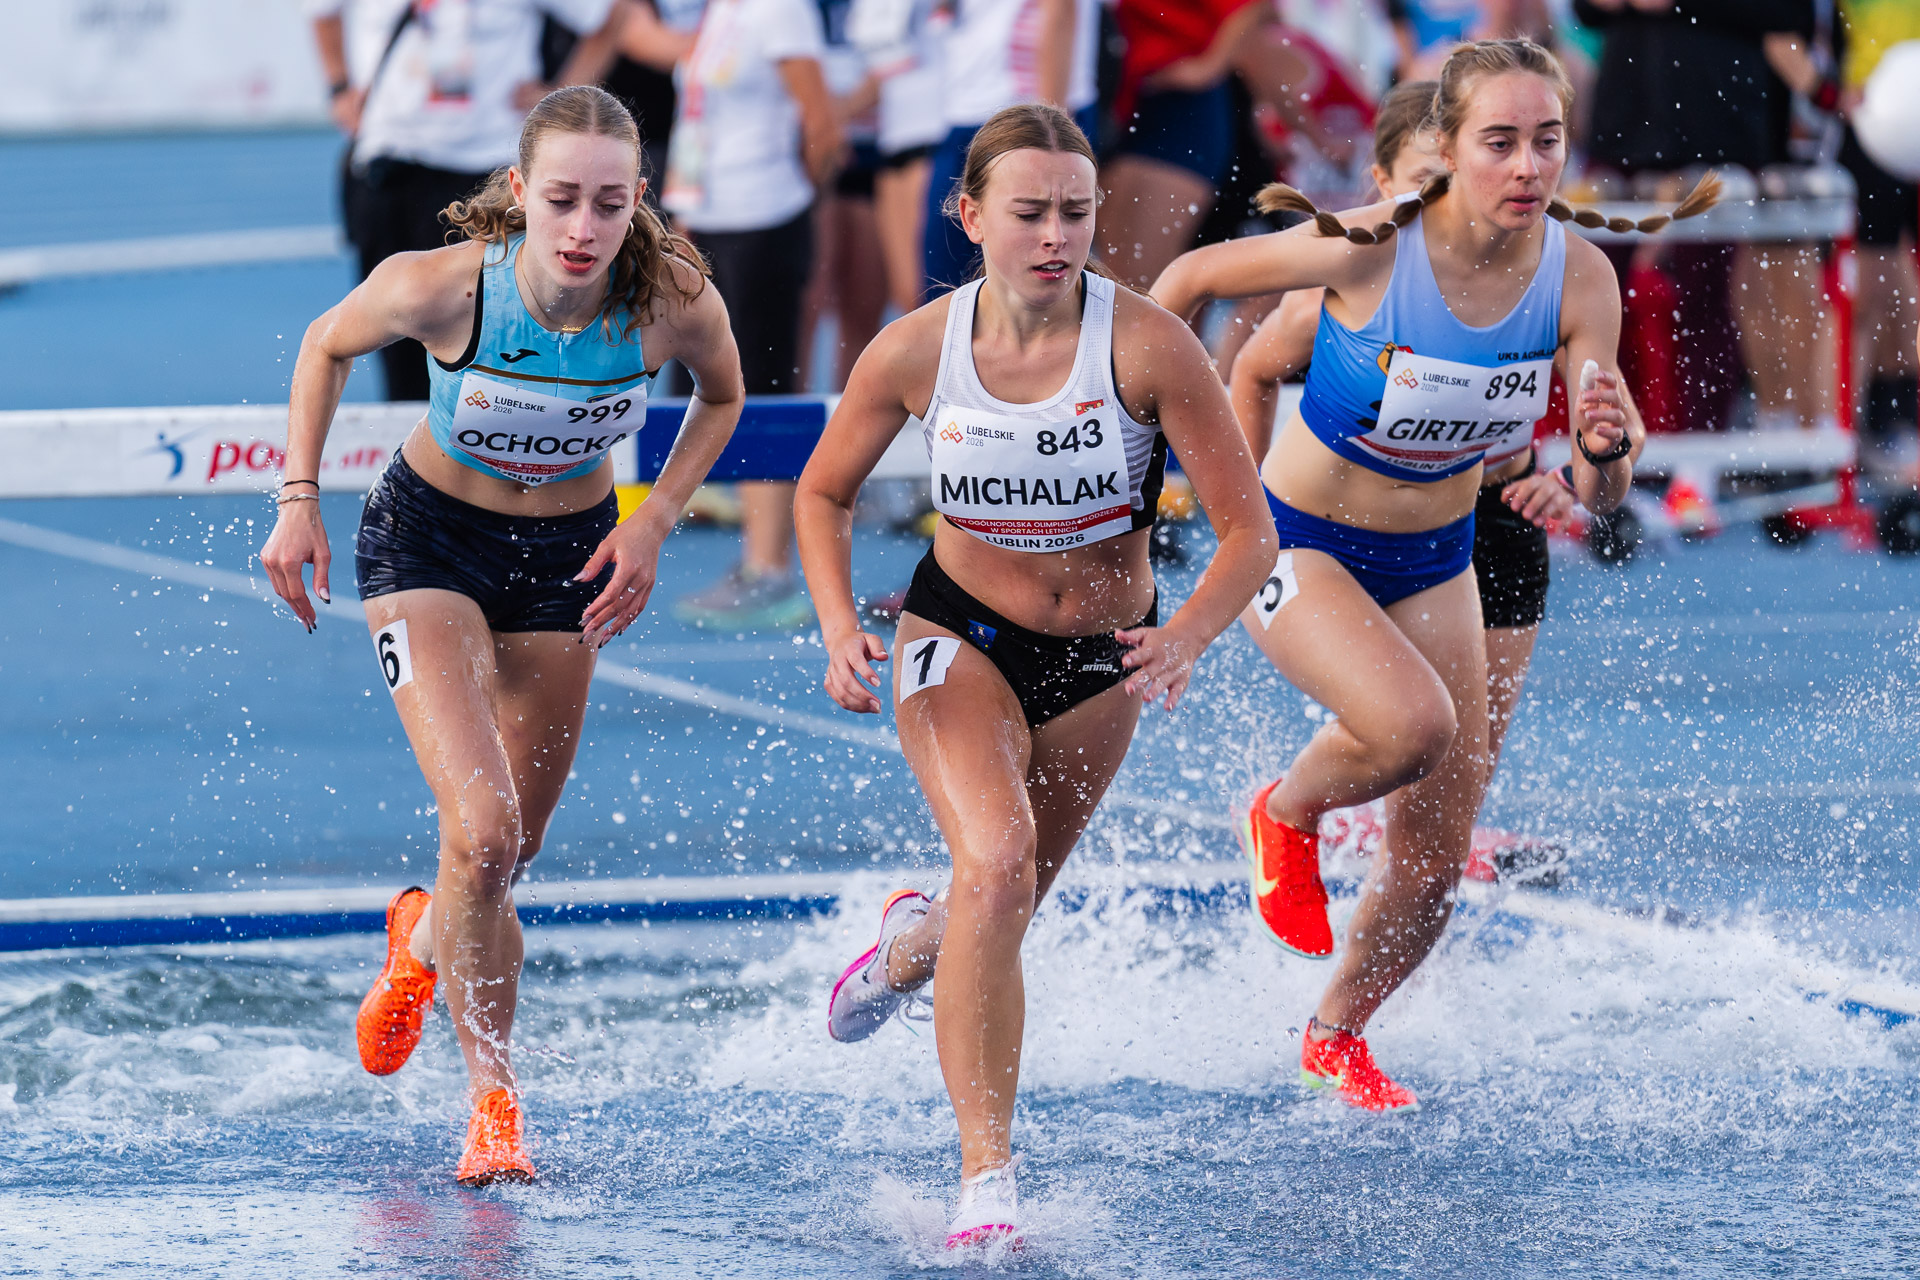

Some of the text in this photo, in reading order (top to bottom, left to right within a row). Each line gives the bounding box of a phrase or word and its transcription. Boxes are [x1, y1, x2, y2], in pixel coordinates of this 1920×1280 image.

[1497, 351, 1519, 361] UKS
[1420, 382, 1439, 393] 2026
[1422, 371, 1471, 388] LUBELSKIE
[1484, 369, 1537, 401] 894
[492, 404, 513, 415] 2026
[494, 395, 547, 413] LUBELSKIE
[567, 398, 632, 424] 999
[966, 424, 1015, 441] LUBELSKIE
[1036, 418, 1104, 456] 843
[965, 436, 985, 448] 2026
[1386, 457, 1435, 470] LUBLIN
[940, 470, 1120, 506] MICHALAK
[967, 520, 1032, 528] OGÓLNOPOLSKA
[1033, 520, 1078, 528] OLIMPIADA
[1000, 527, 1044, 535] SPORTACH
[1045, 526, 1078, 535] LETNICH
[985, 533, 1085, 549] LUBLIN 2026
[378, 632, 400, 688] 6
[912, 639, 939, 686] 1
[1082, 662, 1114, 672] erima
